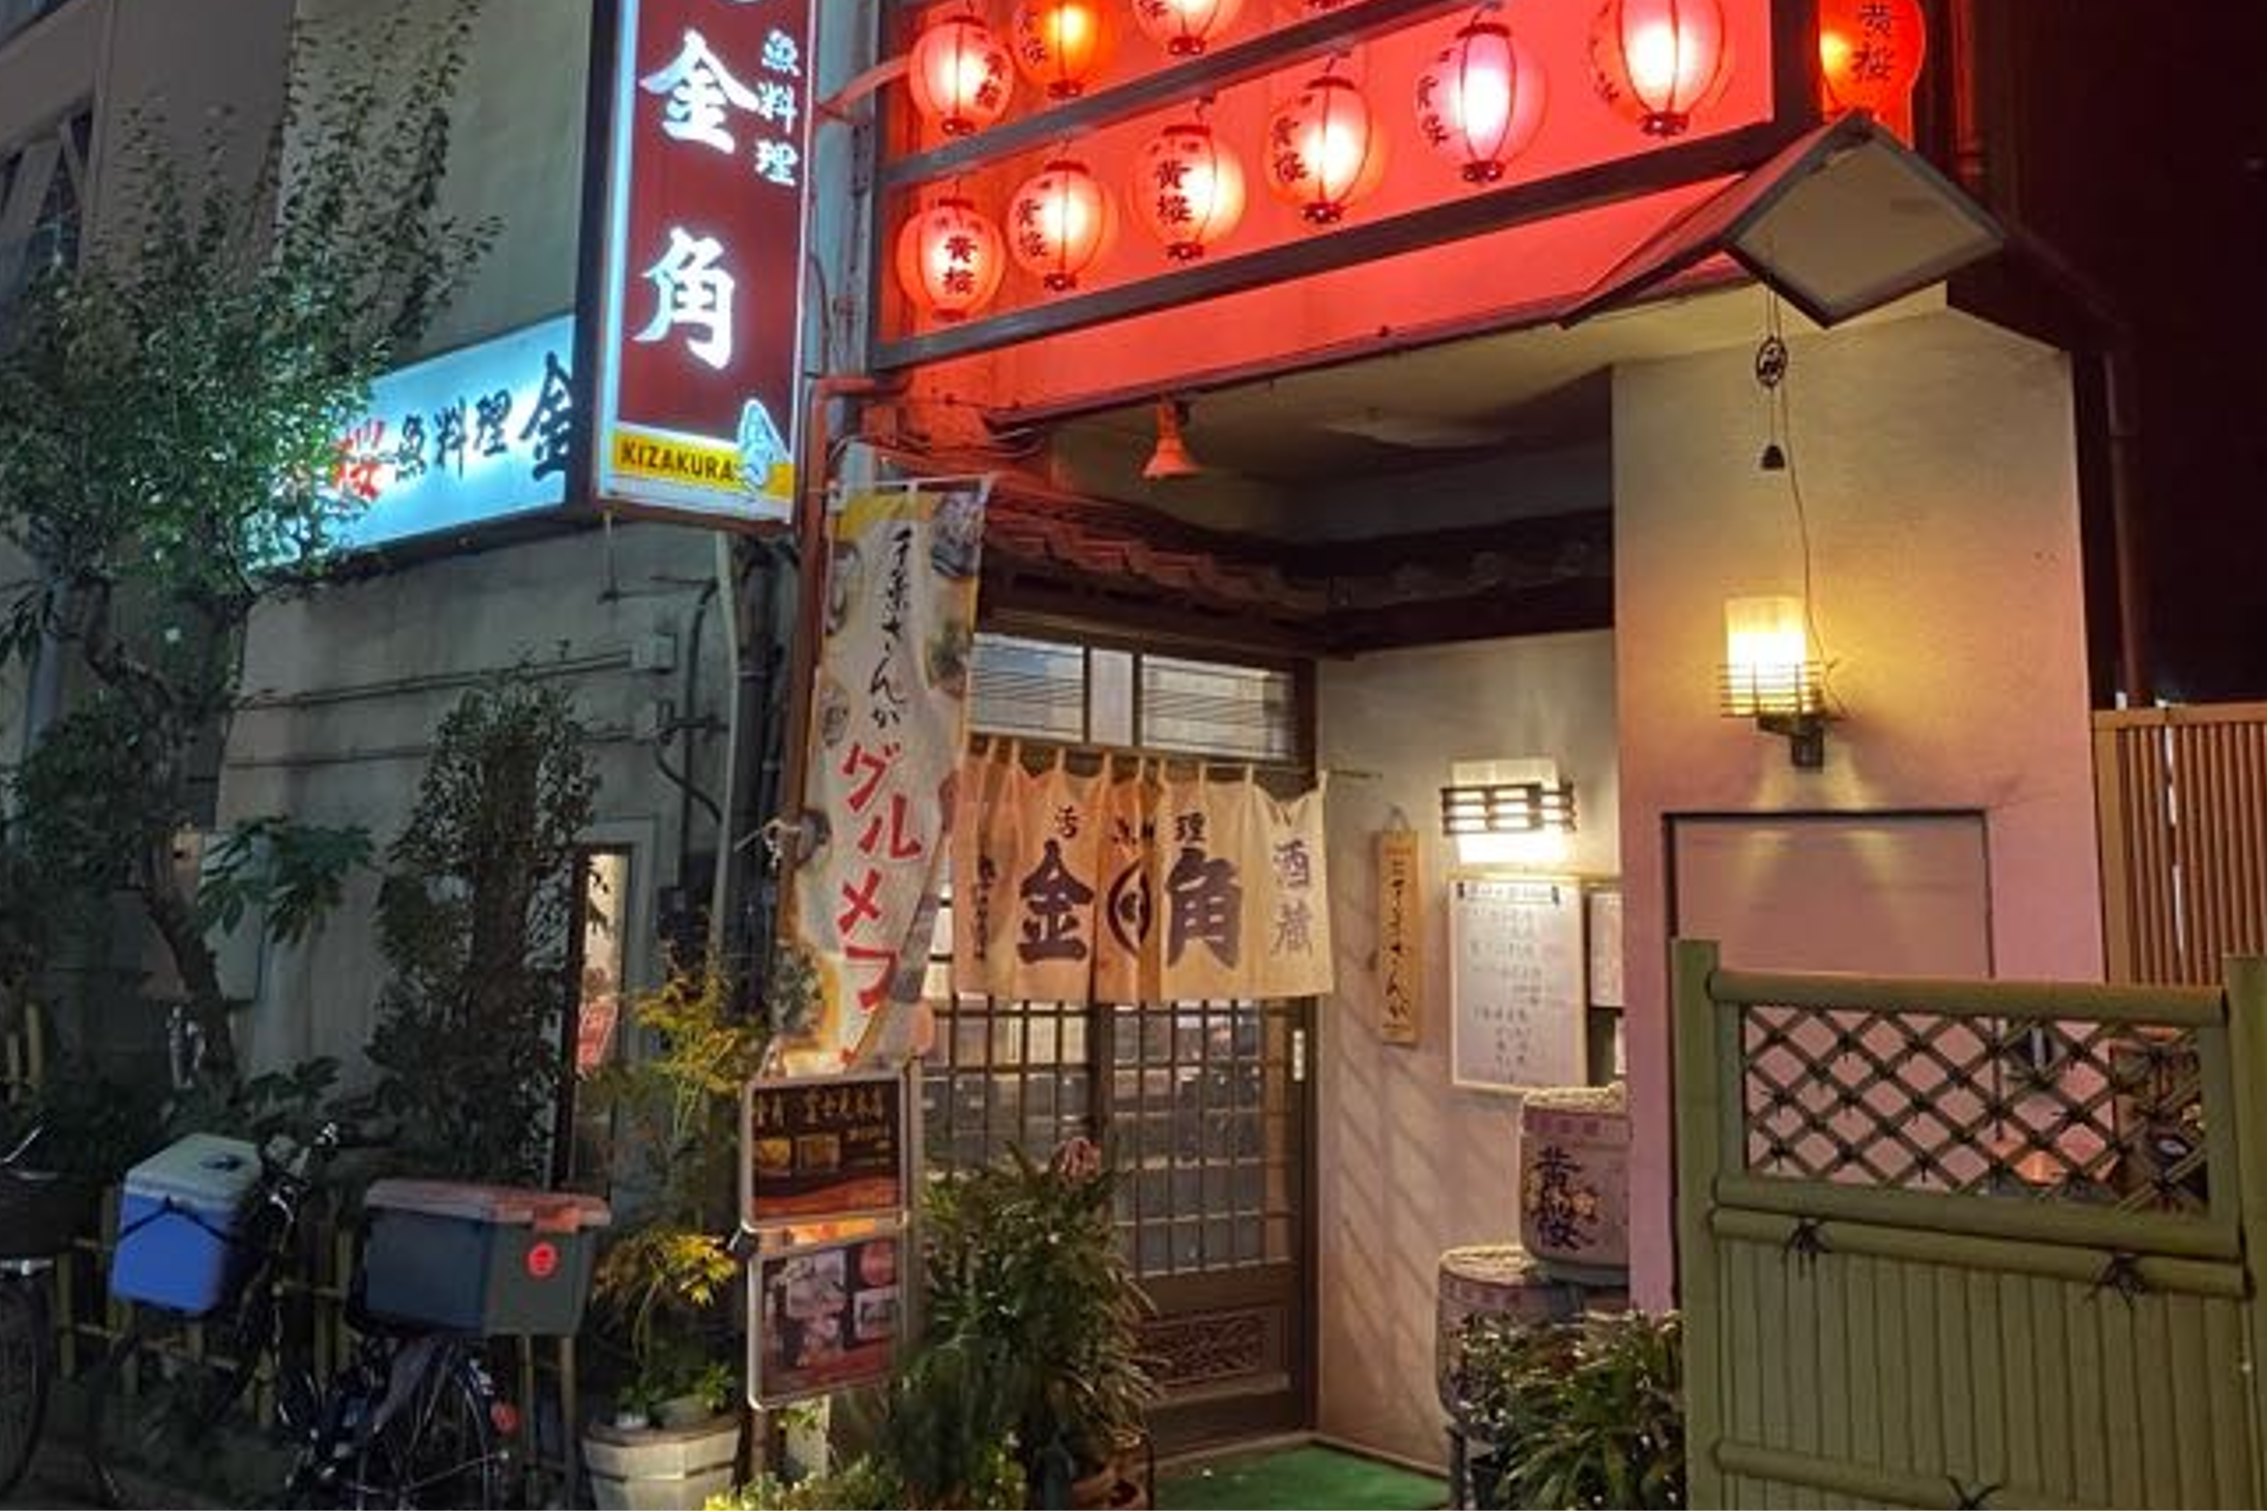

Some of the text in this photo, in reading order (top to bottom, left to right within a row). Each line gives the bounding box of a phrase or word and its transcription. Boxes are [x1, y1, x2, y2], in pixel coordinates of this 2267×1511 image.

[754, 29, 803, 187] 魚料理
[632, 28, 759, 370] 金角
[944, 233, 977, 295] 黄桜
[620, 437, 736, 485] KIZAKURA
